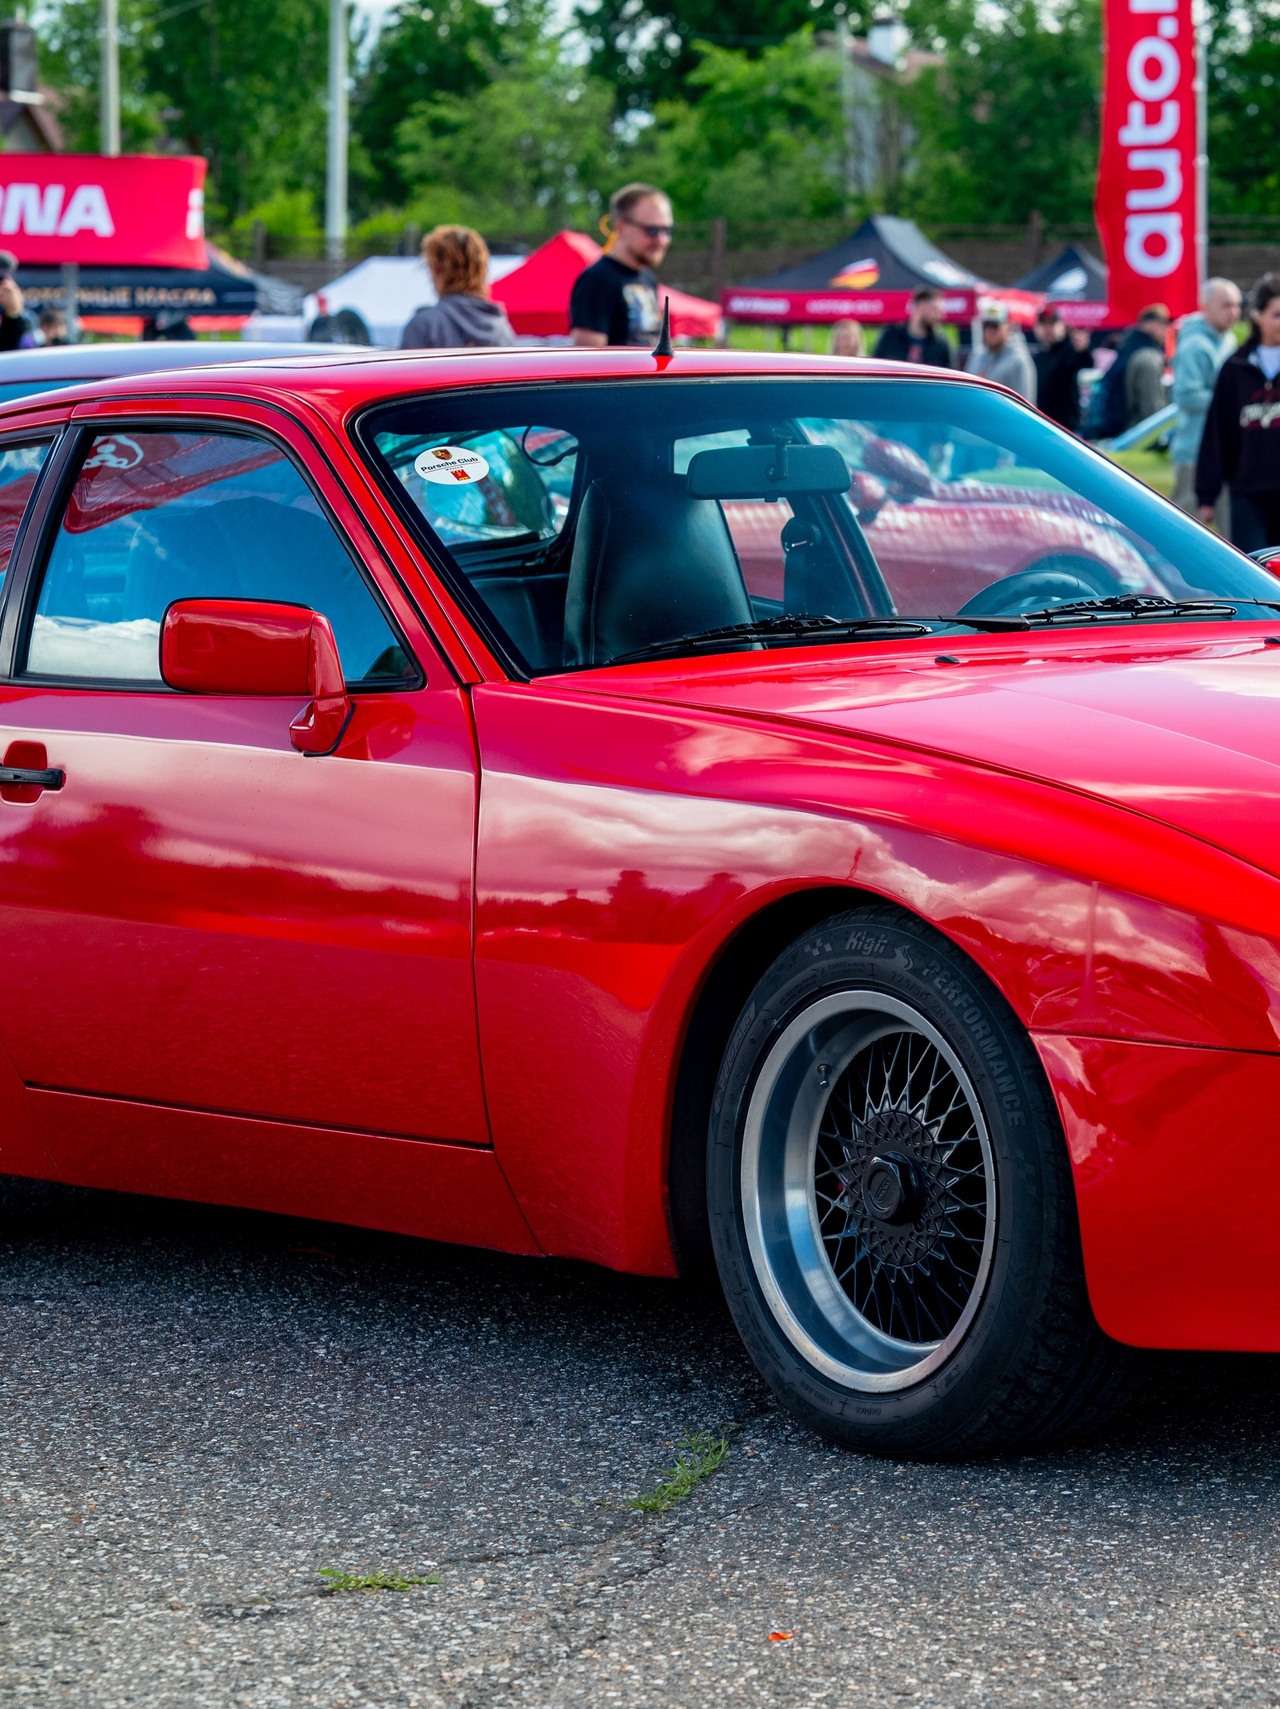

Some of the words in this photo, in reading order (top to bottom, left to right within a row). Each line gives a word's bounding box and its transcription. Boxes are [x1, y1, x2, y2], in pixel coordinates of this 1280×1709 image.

[0, 182, 116, 238] NA
[420, 460, 457, 472] Porsche
[845, 930, 888, 957] High
[920, 957, 1026, 1128] PERFORMANCE
